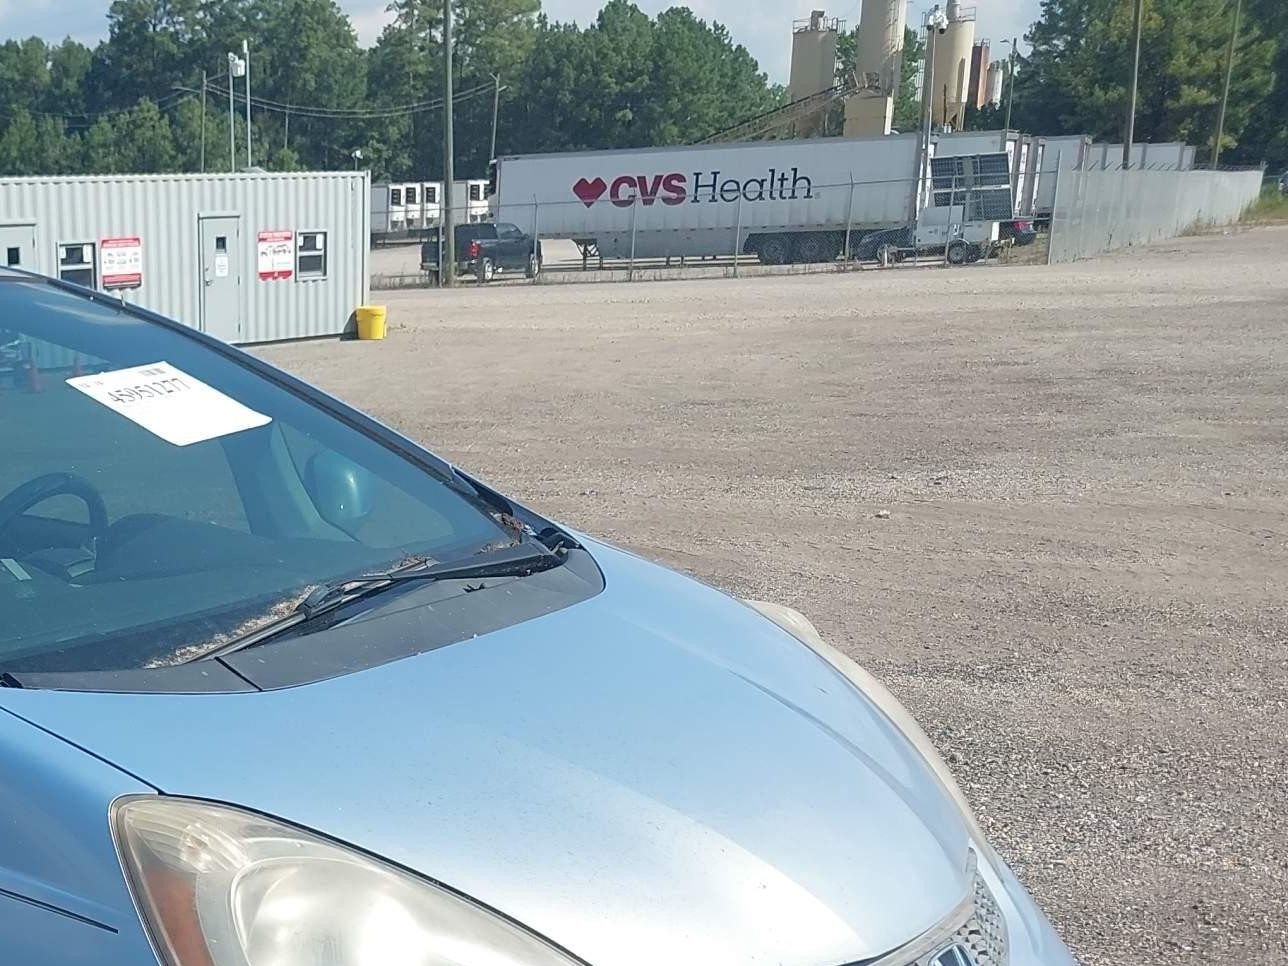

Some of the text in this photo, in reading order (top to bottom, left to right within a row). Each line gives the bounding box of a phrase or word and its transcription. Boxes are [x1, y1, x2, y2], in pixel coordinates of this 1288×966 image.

[609, 168, 814, 208] CVS Health
[107, 377, 191, 404] 45951277
